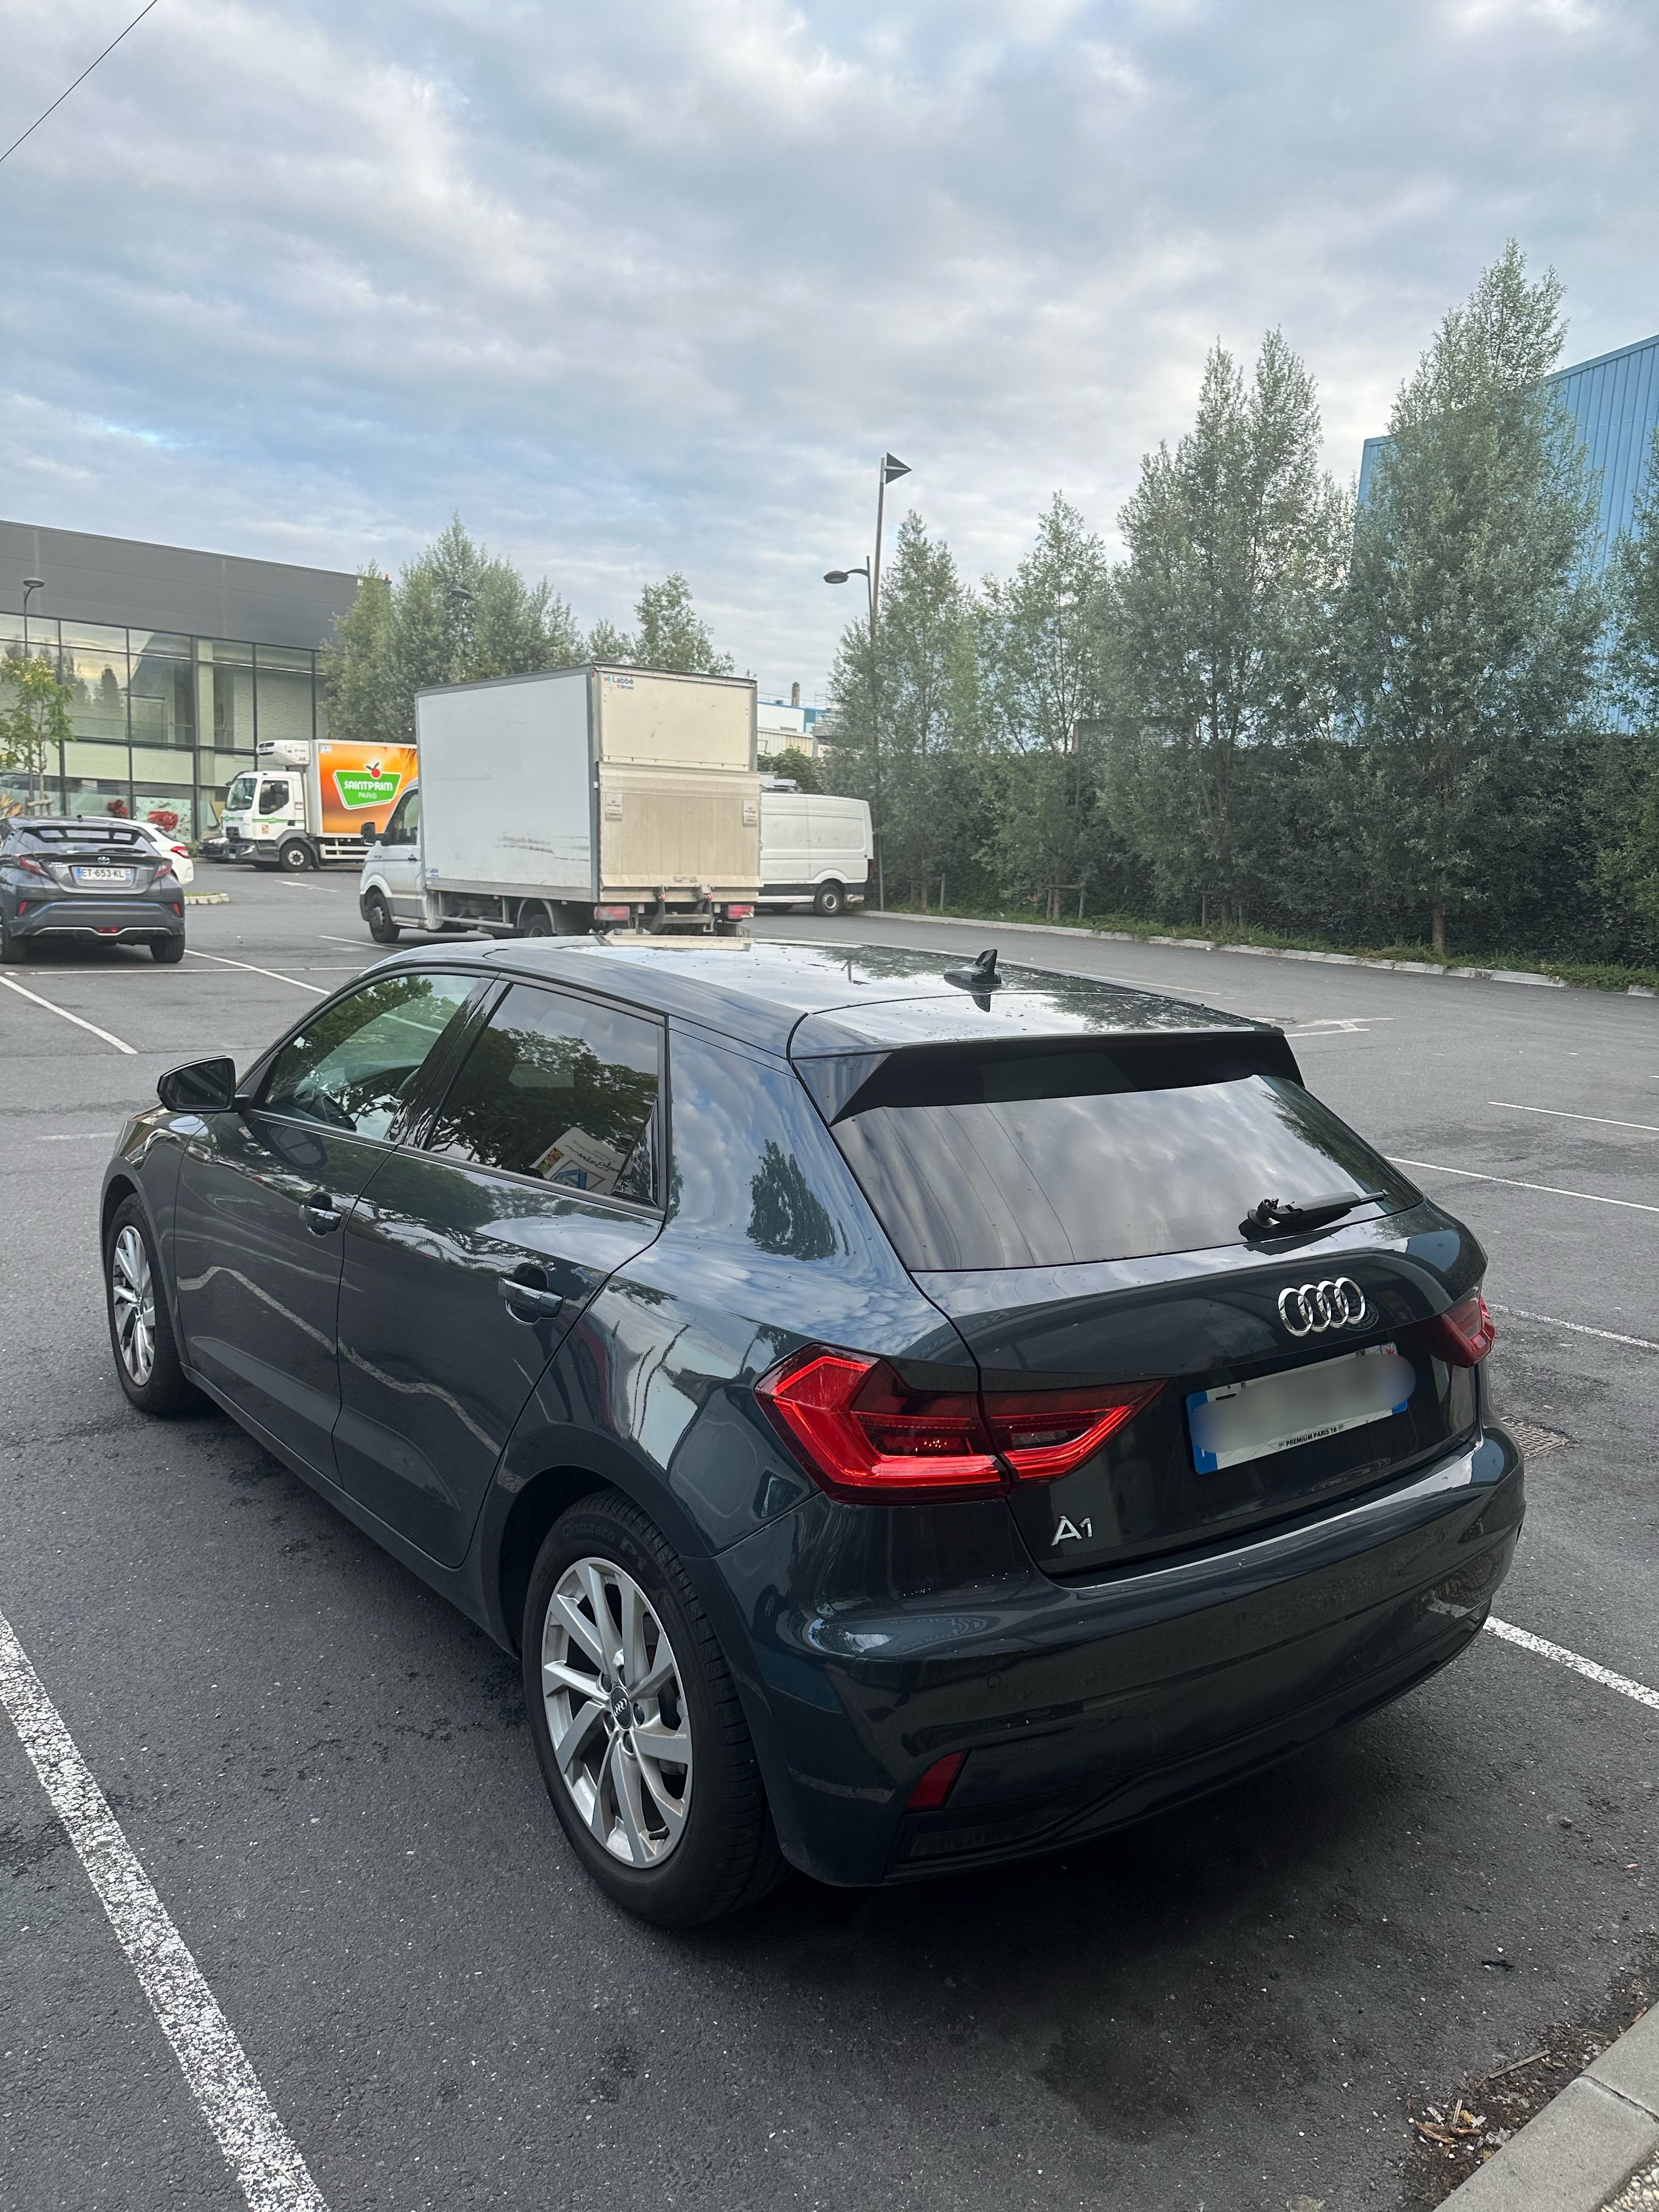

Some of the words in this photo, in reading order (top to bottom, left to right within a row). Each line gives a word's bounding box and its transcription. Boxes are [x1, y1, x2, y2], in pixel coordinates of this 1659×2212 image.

[612, 675, 634, 684] Labbé
[344, 780, 393, 791] SAINTPRIM
[82, 867, 125, 878] ET-653-KL
[1285, 1434, 1313, 1447] PREMIUM
[1313, 1429, 1329, 1438] PARIS
[1051, 1515, 1093, 1547] A1
